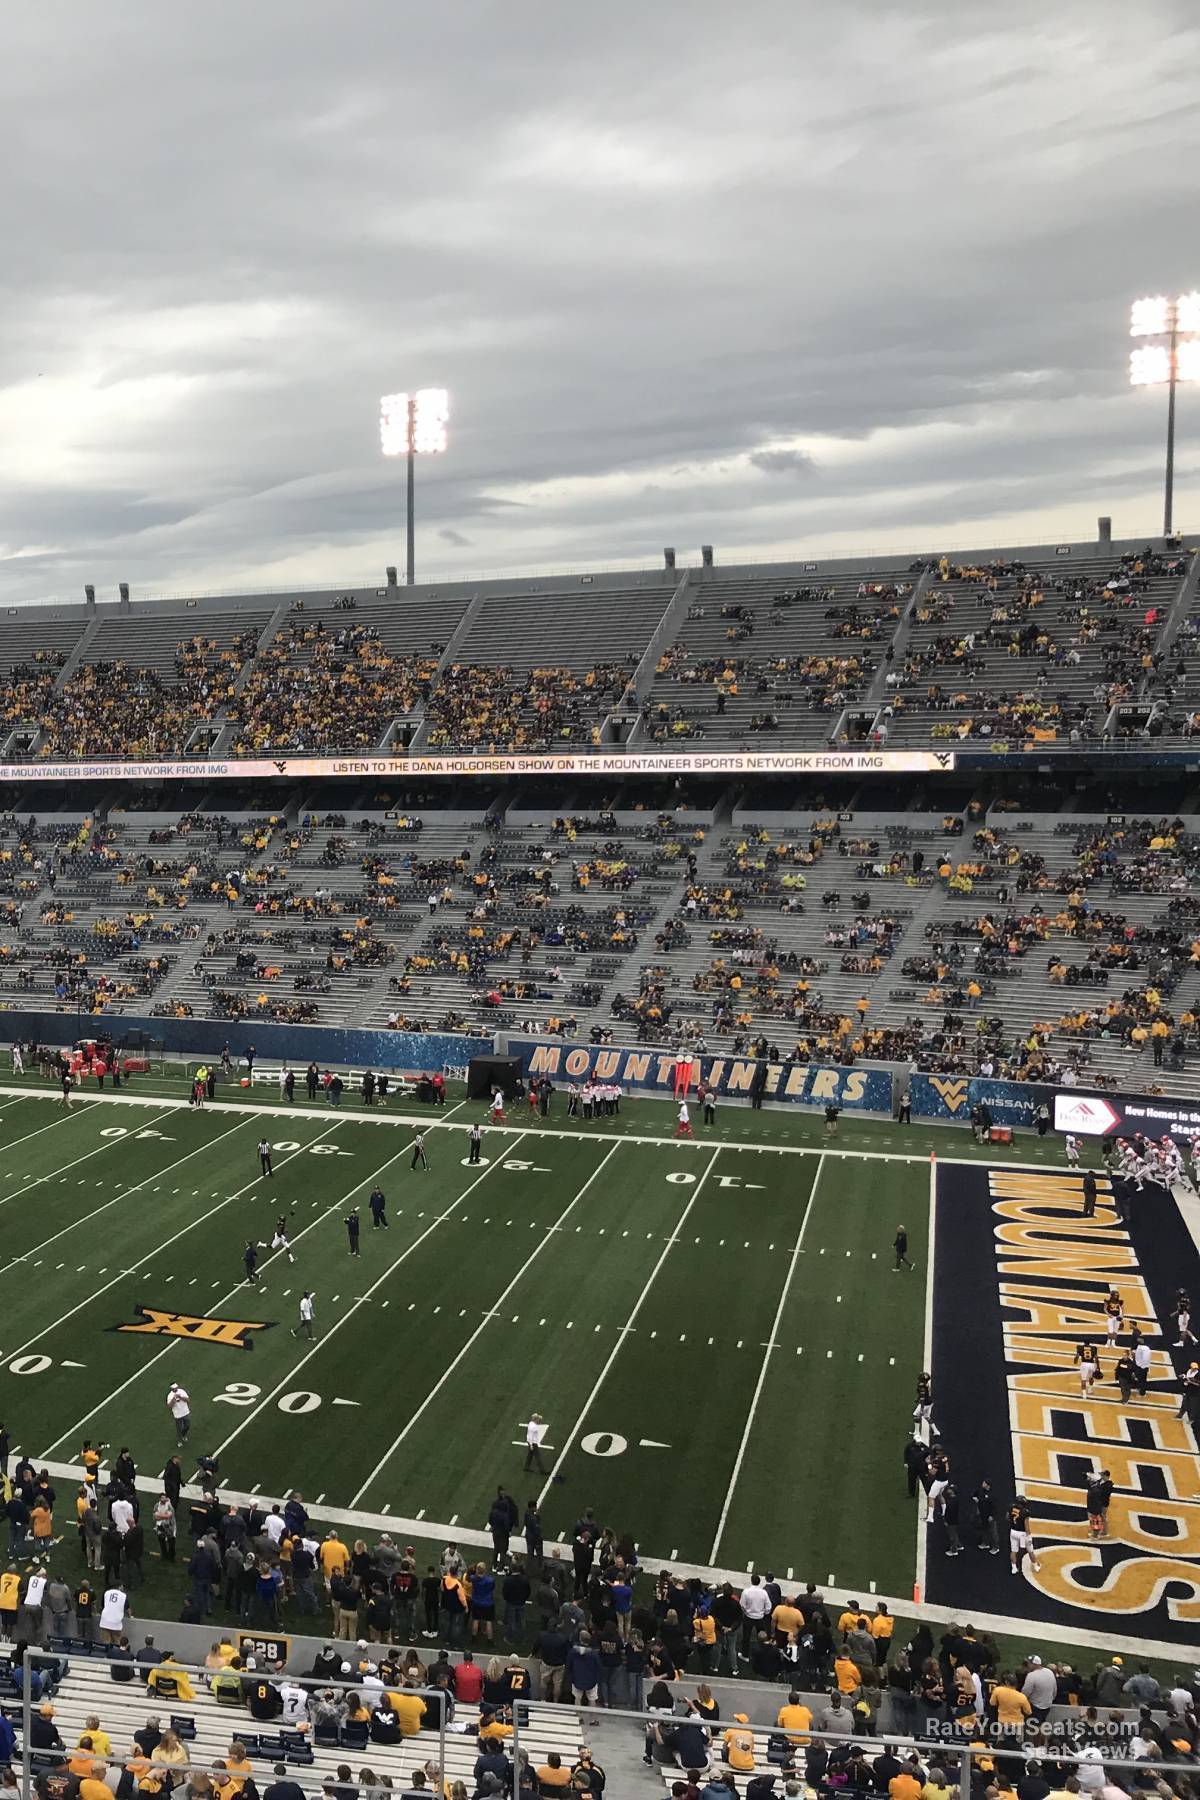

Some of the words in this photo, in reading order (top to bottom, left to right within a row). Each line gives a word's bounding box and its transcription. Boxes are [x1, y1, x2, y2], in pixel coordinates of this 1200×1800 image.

[11, 767, 81, 777] MOUNTAINEER
[83, 766, 121, 776] SPORTS
[123, 766, 174, 776] NETWORK
[176, 765, 206, 774] FROM
[208, 764, 228, 774] IMG
[333, 762, 369, 772] LISTEN
[370, 762, 387, 772] TO
[389, 762, 410, 772] THE
[412, 762, 444, 771] DANA
[446, 760, 516, 770] HOLGORSEN
[518, 760, 554, 770] SHOW
[556, 760, 576, 770] ON
[578, 759, 600, 770] THE
[603, 758, 691, 770] MOUNTAINEER
[694, 758, 744, 768] SPORTS
[746, 758, 812, 768] NETWORK
[816, 757, 853, 768] FROM
[857, 757, 883, 767] IMG
[528, 1045, 869, 1101] MOUNTAINEERS
[981, 1095, 1034, 1110] NISSAN
[1125, 1105, 1145, 1117] New
[1146, 1107, 1178, 1120] Homes
[1179, 1110, 1188, 1121] in
[212, 1382, 322, 1414] 20
[987, 1170, 1200, 1625] MOUNTAINEERS
[4, 1582, 12, 1593] 7
[32, 1579, 38, 1588] 8
[78, 1592, 88, 1604] 18
[510, 1674, 524, 1689] 12
[258, 1686, 266, 1698] 8
[288, 1698, 299, 1713] 7
